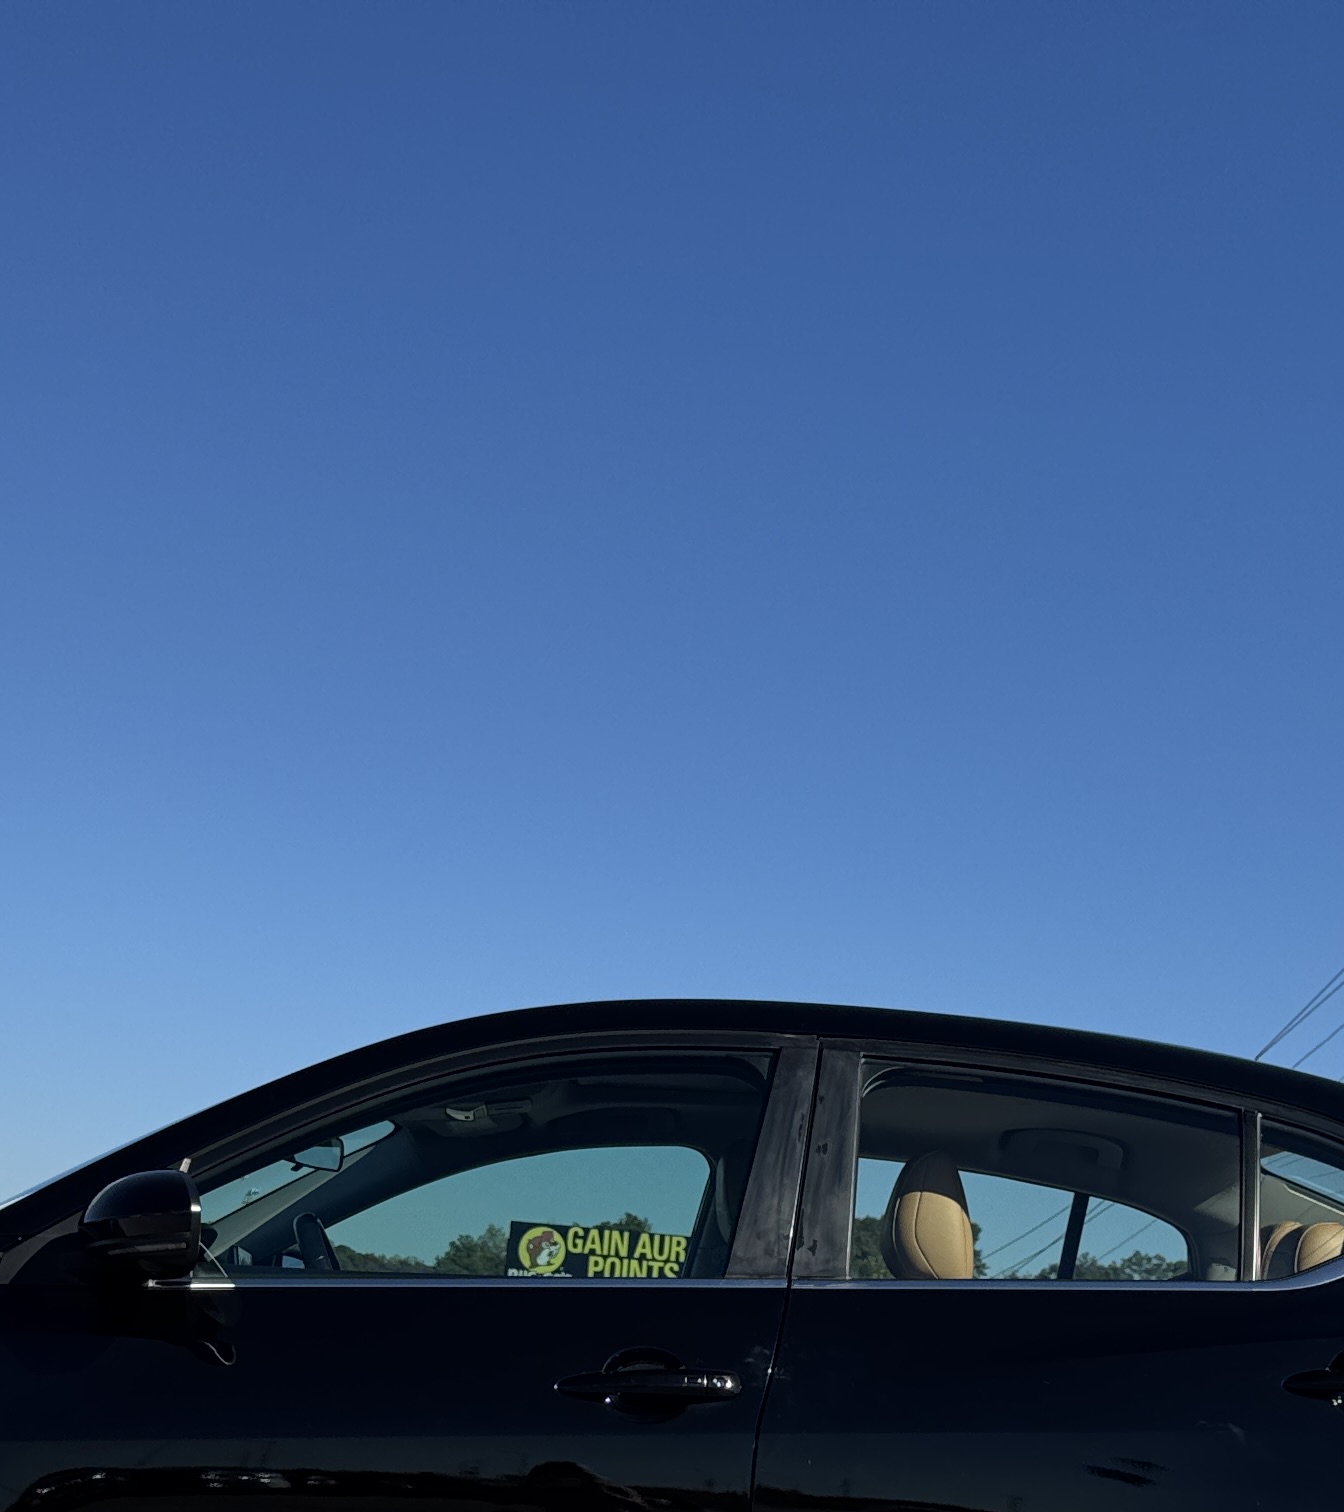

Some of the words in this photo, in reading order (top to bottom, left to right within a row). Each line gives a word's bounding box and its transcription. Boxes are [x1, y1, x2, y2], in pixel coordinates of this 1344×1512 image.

[566, 1226, 630, 1258] GAIN
[634, 1232, 687, 1263] AUR
[587, 1255, 680, 1278] POINTS
